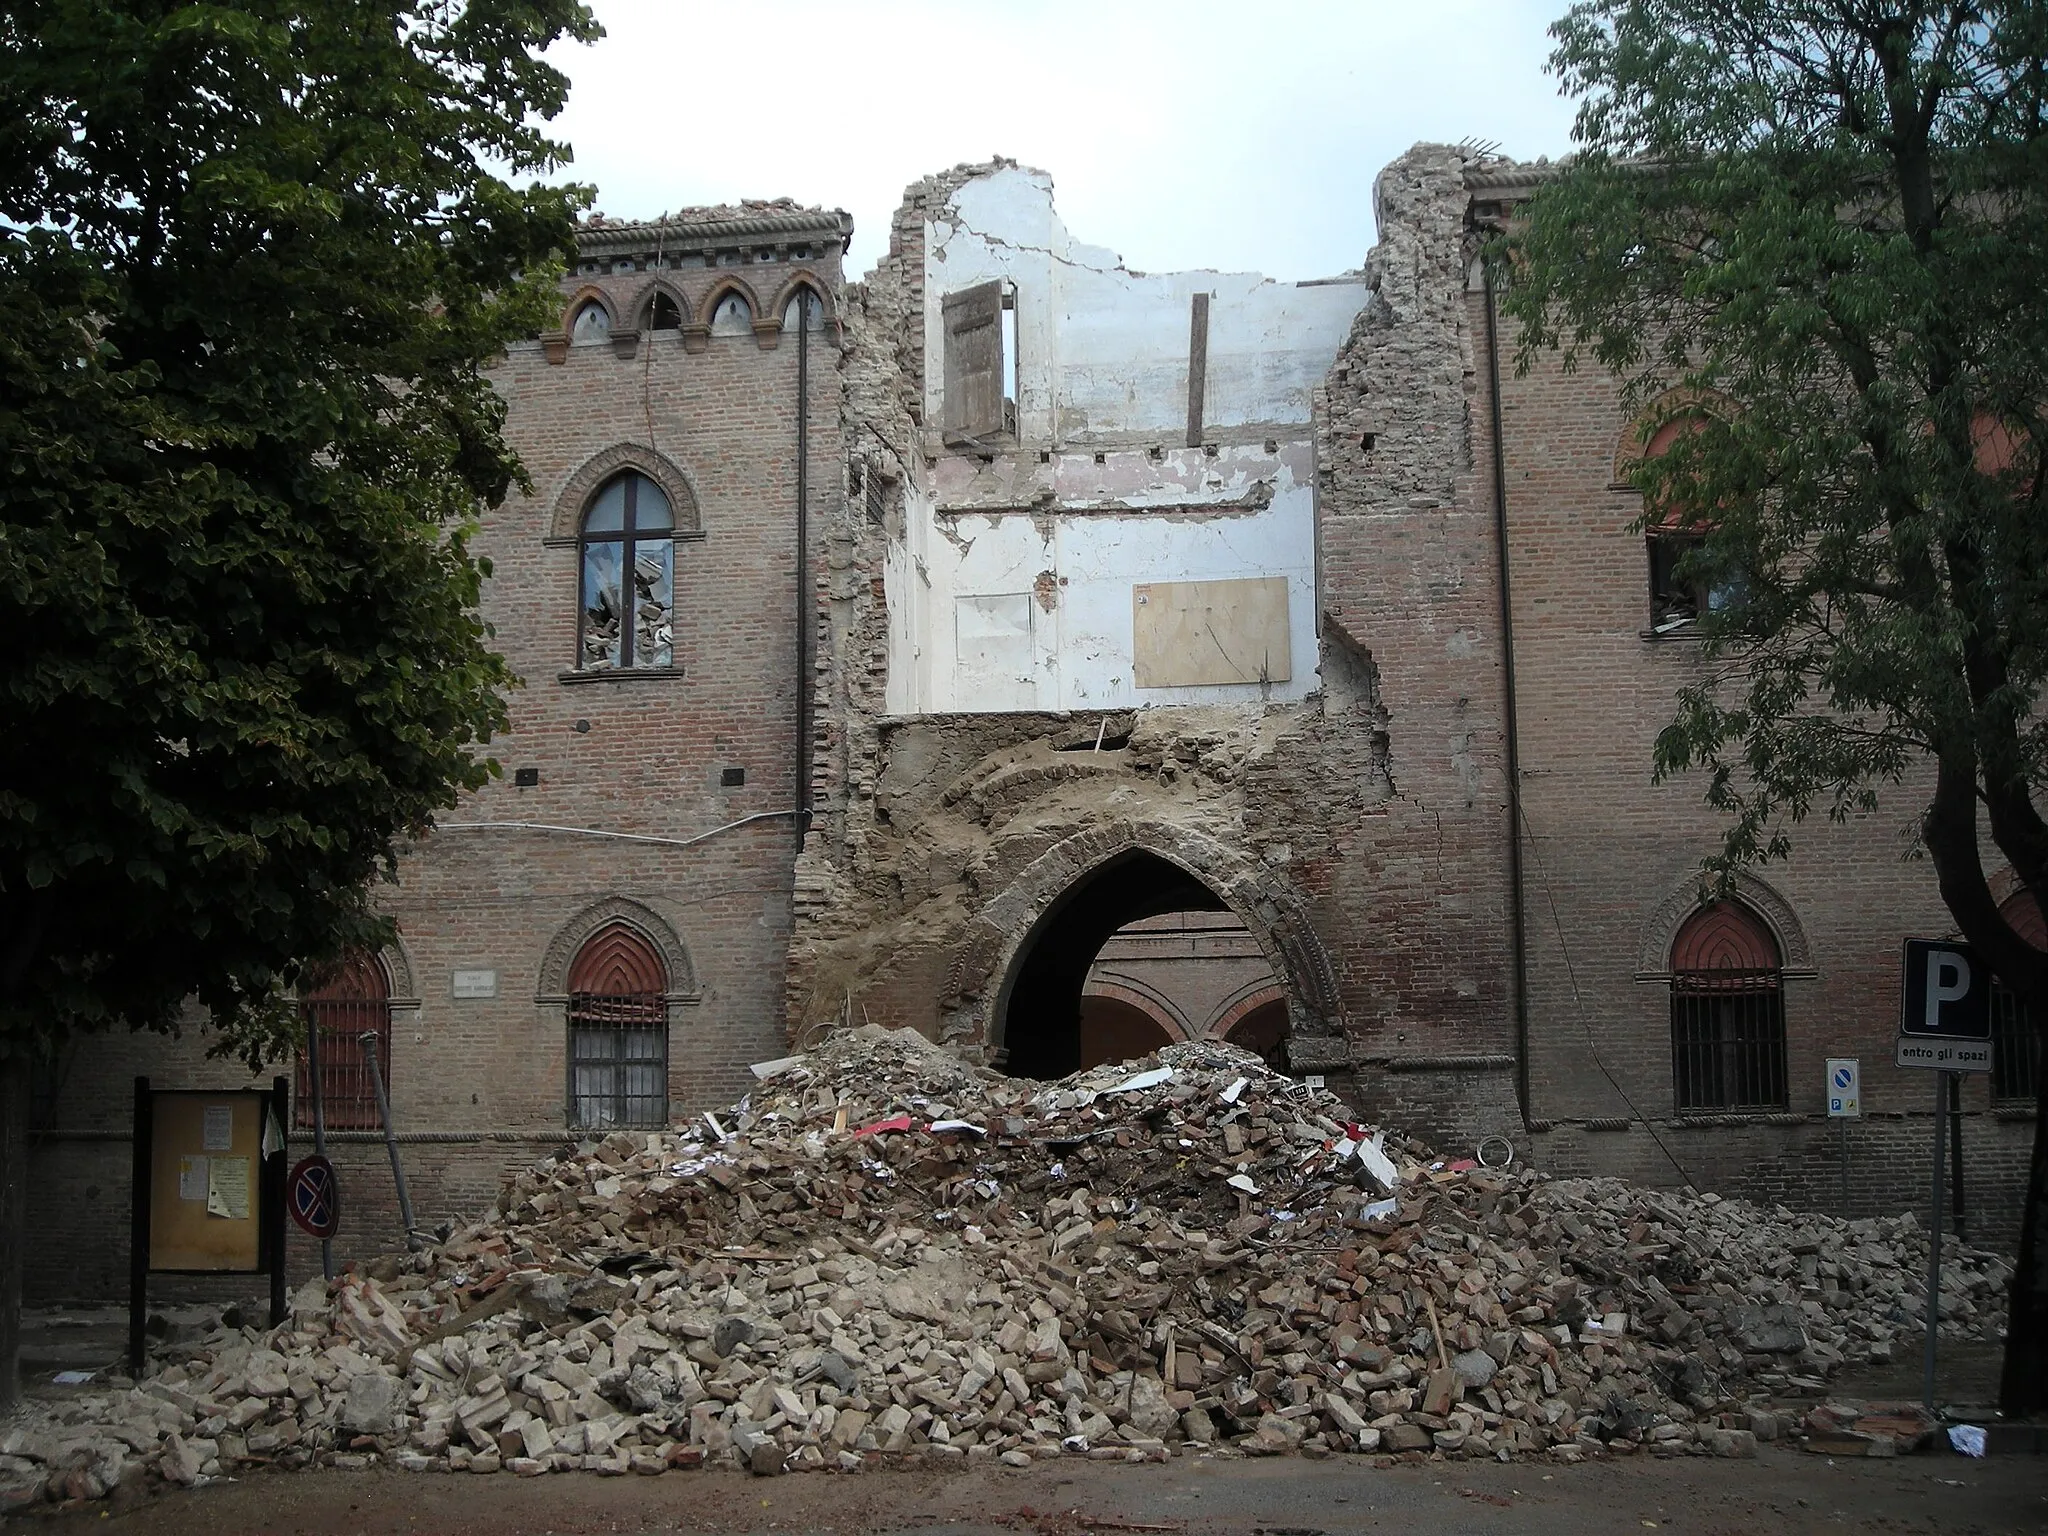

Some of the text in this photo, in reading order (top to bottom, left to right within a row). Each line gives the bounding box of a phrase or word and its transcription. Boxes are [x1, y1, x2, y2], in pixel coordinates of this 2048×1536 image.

[1925, 950, 1971, 1026] P
[1902, 1047, 1988, 1062] entro gli spazi
[1833, 1100, 1840, 1109] P
